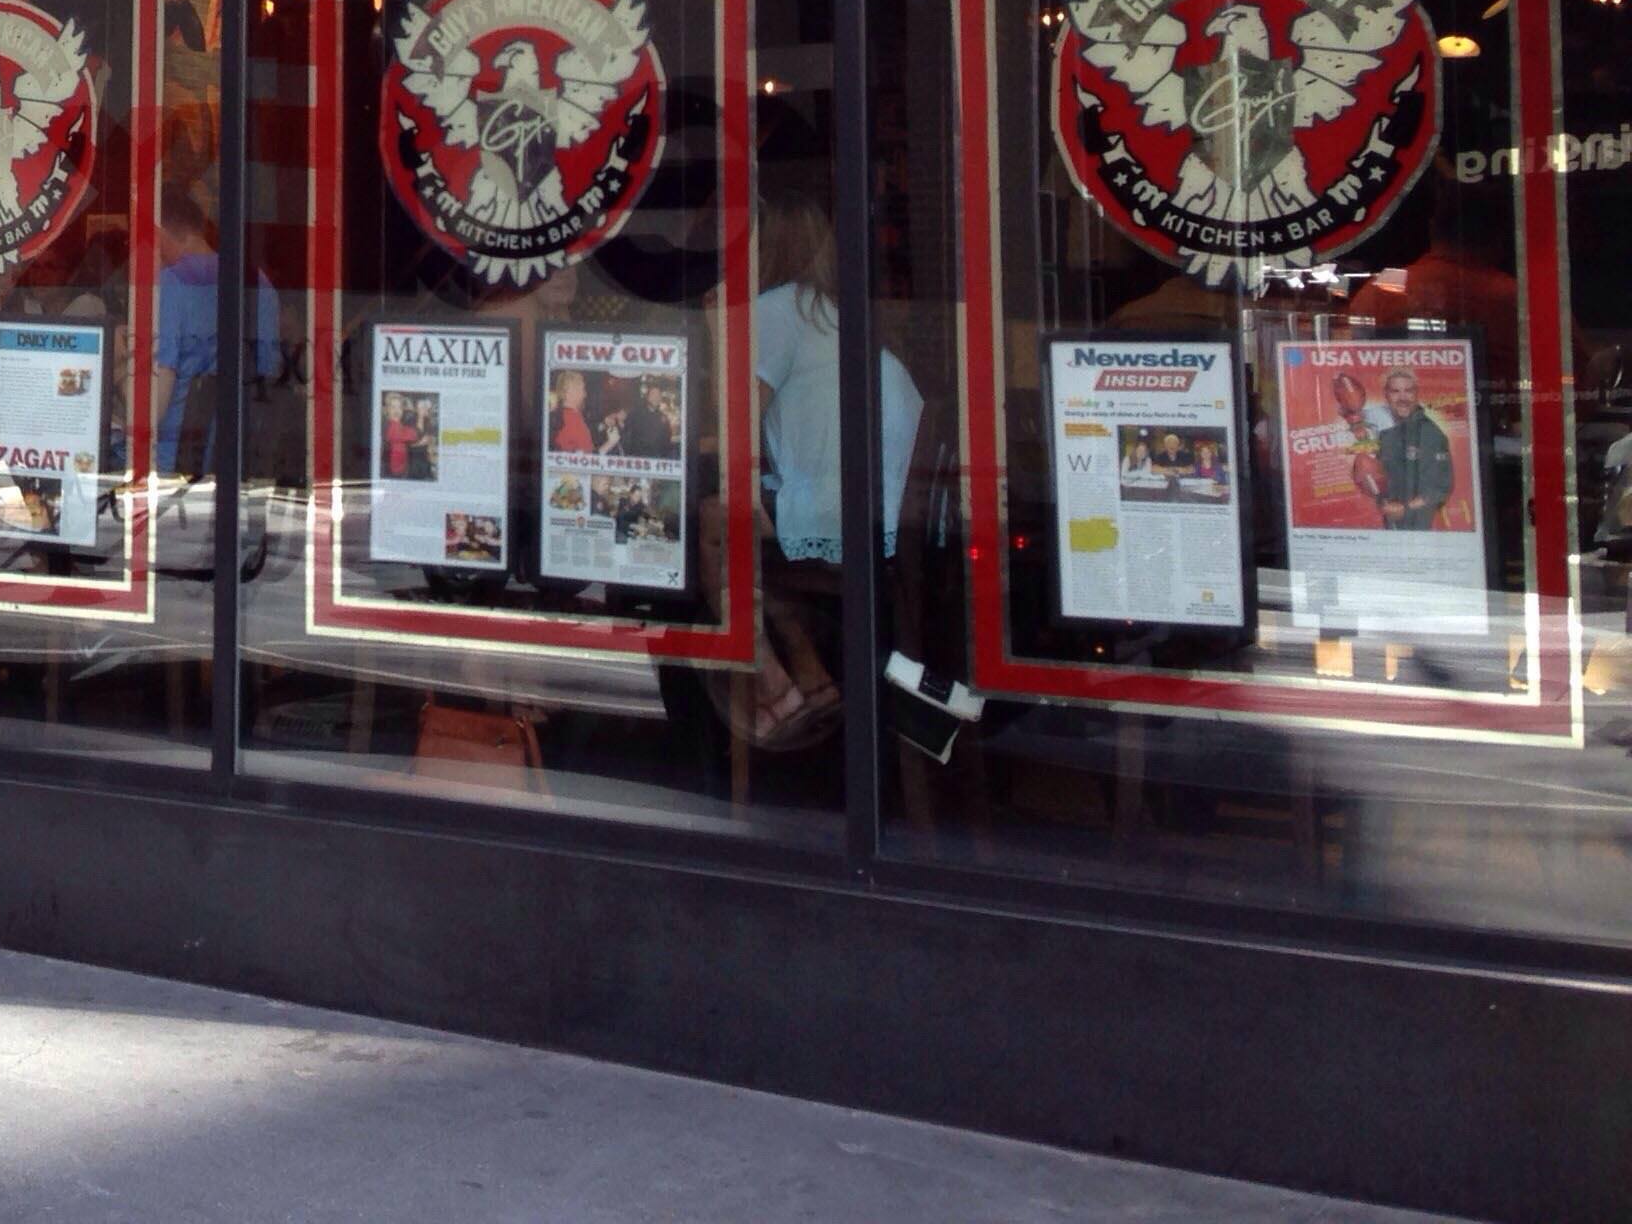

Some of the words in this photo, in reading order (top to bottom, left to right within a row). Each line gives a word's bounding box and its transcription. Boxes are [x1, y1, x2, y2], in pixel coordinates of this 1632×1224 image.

[428, 0, 486, 52] GUY'S
[4, 221, 32, 246] BAR
[455, 216, 533, 249] KITCHEN
[549, 214, 584, 243] BAR
[1161, 205, 1265, 247] KITCHEN
[1287, 208, 1335, 240] BAR
[16, 332, 48, 348] DAILY
[51, 333, 77, 349] NYC
[382, 336, 505, 366] MAXIM
[557, 343, 615, 363] NEW
[622, 345, 676, 365] GUY
[1073, 347, 1216, 374] Newsday
[1312, 350, 1351, 366] USA
[1357, 350, 1465, 367] WEEKEND
[1103, 373, 1189, 390] INSIDER
[1067, 453, 1092, 473] W
